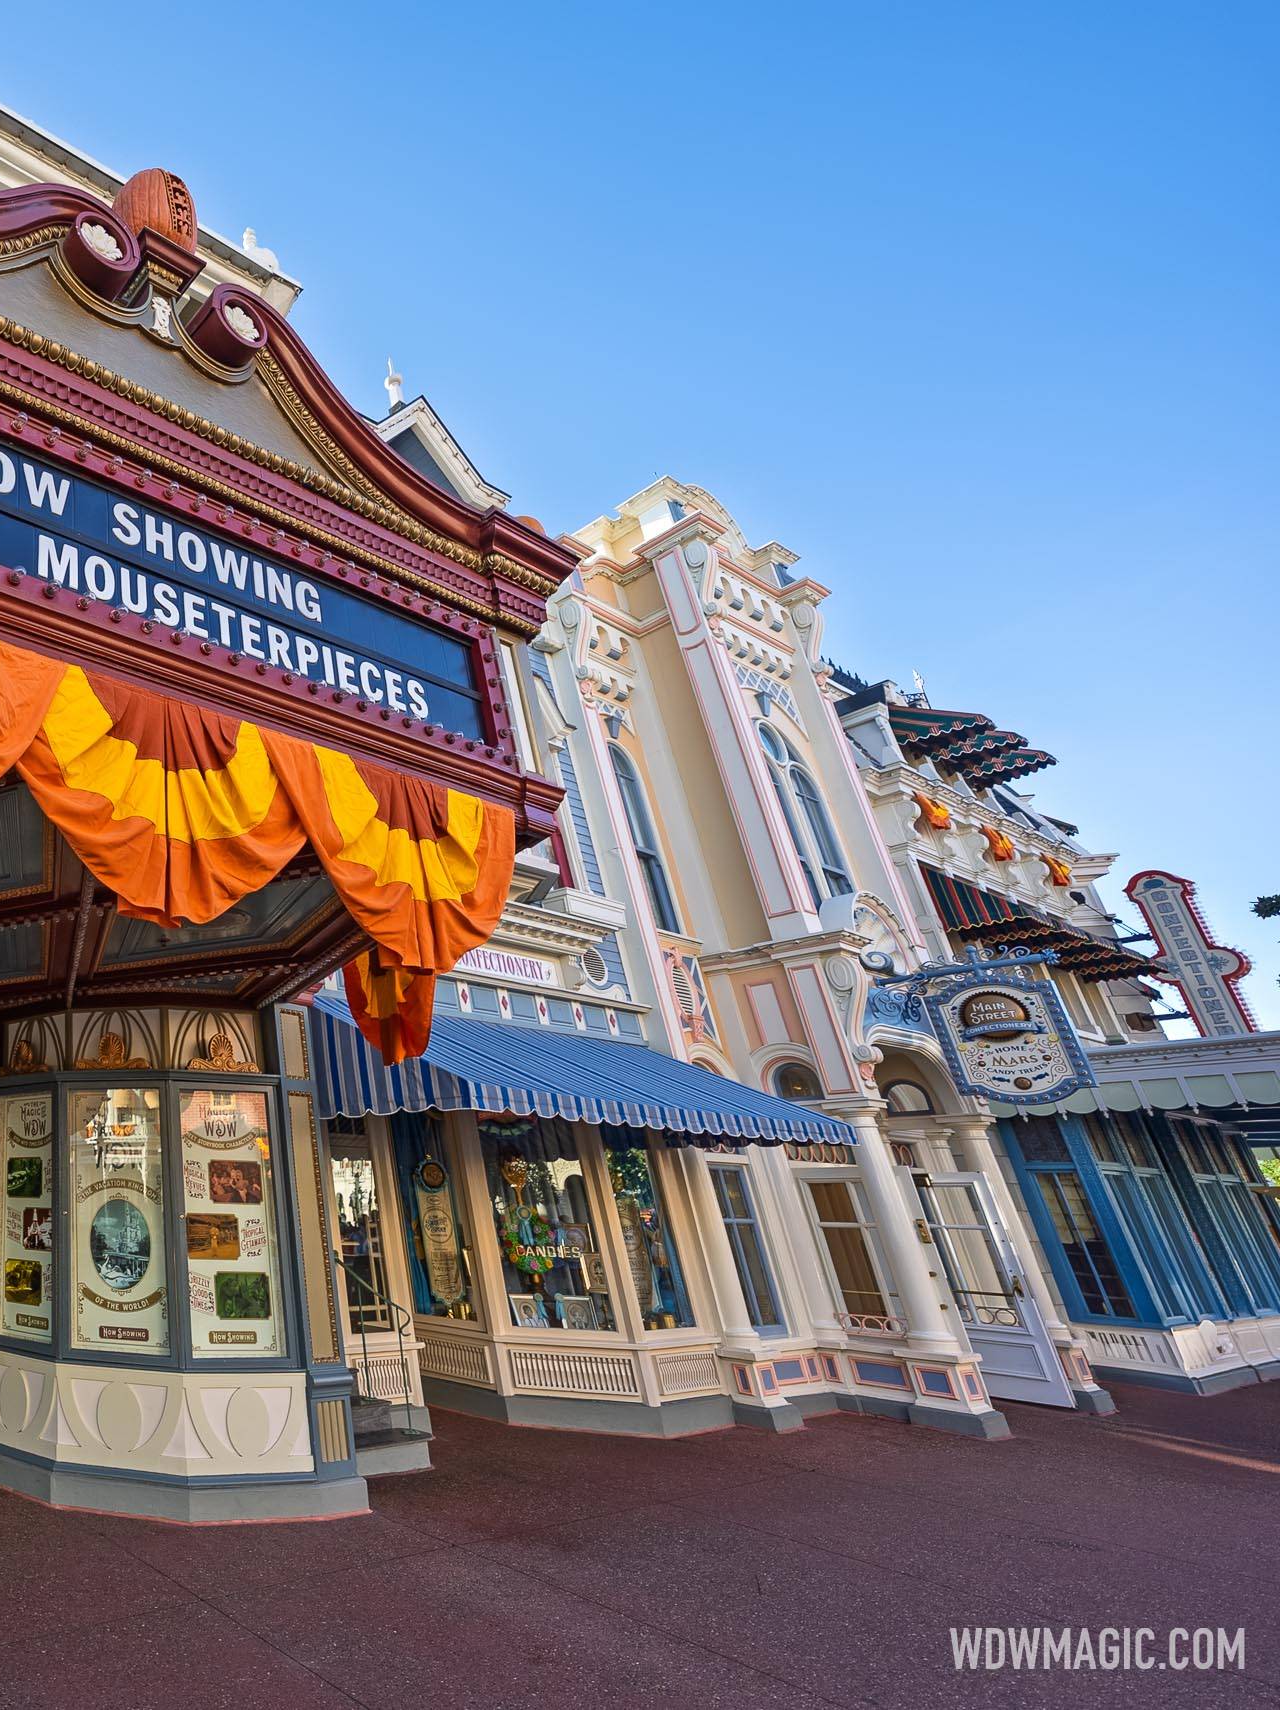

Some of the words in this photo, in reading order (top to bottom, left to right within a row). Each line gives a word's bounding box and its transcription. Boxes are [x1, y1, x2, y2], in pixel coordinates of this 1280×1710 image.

[111, 502, 323, 624] SHOWING
[36, 535, 431, 721] MOUSETERPIECES
[461, 949, 544, 980] ONFECTIONERY
[971, 1002, 1005, 1012] MAIN
[970, 1011, 1016, 1024] STREET
[966, 1022, 1033, 1035] CONFECTIONERY
[995, 1045, 1027, 1054] HOME
[992, 1054, 1039, 1067] MARS
[986, 1067, 1016, 1075] CANDY
[1019, 1062, 1048, 1074] TREATS
[23, 1119, 47, 1137] WDW
[203, 1119, 237, 1138] WDW
[241, 1226, 265, 1239] TROPICAL
[241, 1236, 267, 1251] GETAWAYS
[516, 1244, 582, 1258] CANDIES
[94, 1296, 106, 1305] OF
[107, 1301, 120, 1310] THE
[122, 1298, 150, 1311] WORLD!
